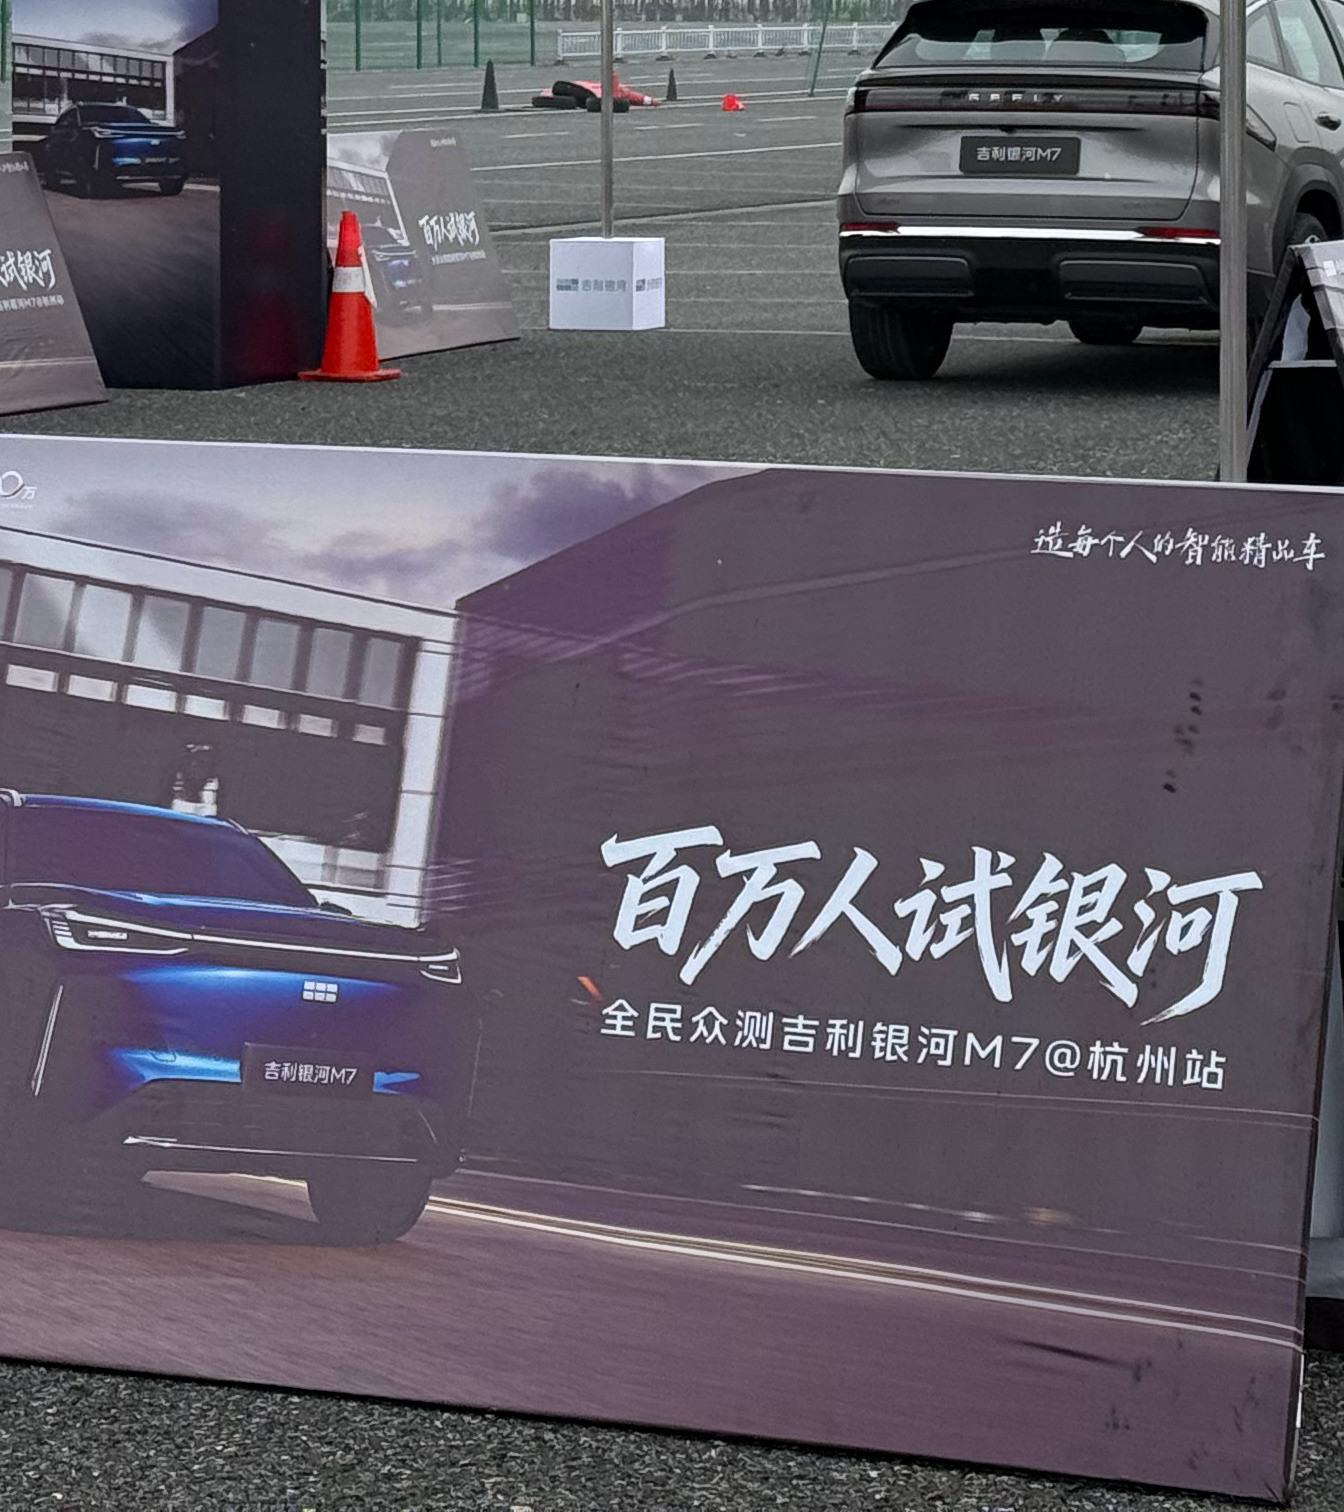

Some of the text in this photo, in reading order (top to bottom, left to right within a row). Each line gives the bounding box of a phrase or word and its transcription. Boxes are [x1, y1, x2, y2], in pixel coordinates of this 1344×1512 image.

[976, 146, 1062, 162] 吉利银河M7
[1030, 521, 1326, 571] 造每个人的智能精品车
[600, 825, 1264, 1025] 百万人试银河
[599, 998, 1226, 1090] 全民众测吉利银河M7@杭州站
[264, 1061, 358, 1085] 吉利银河M7
